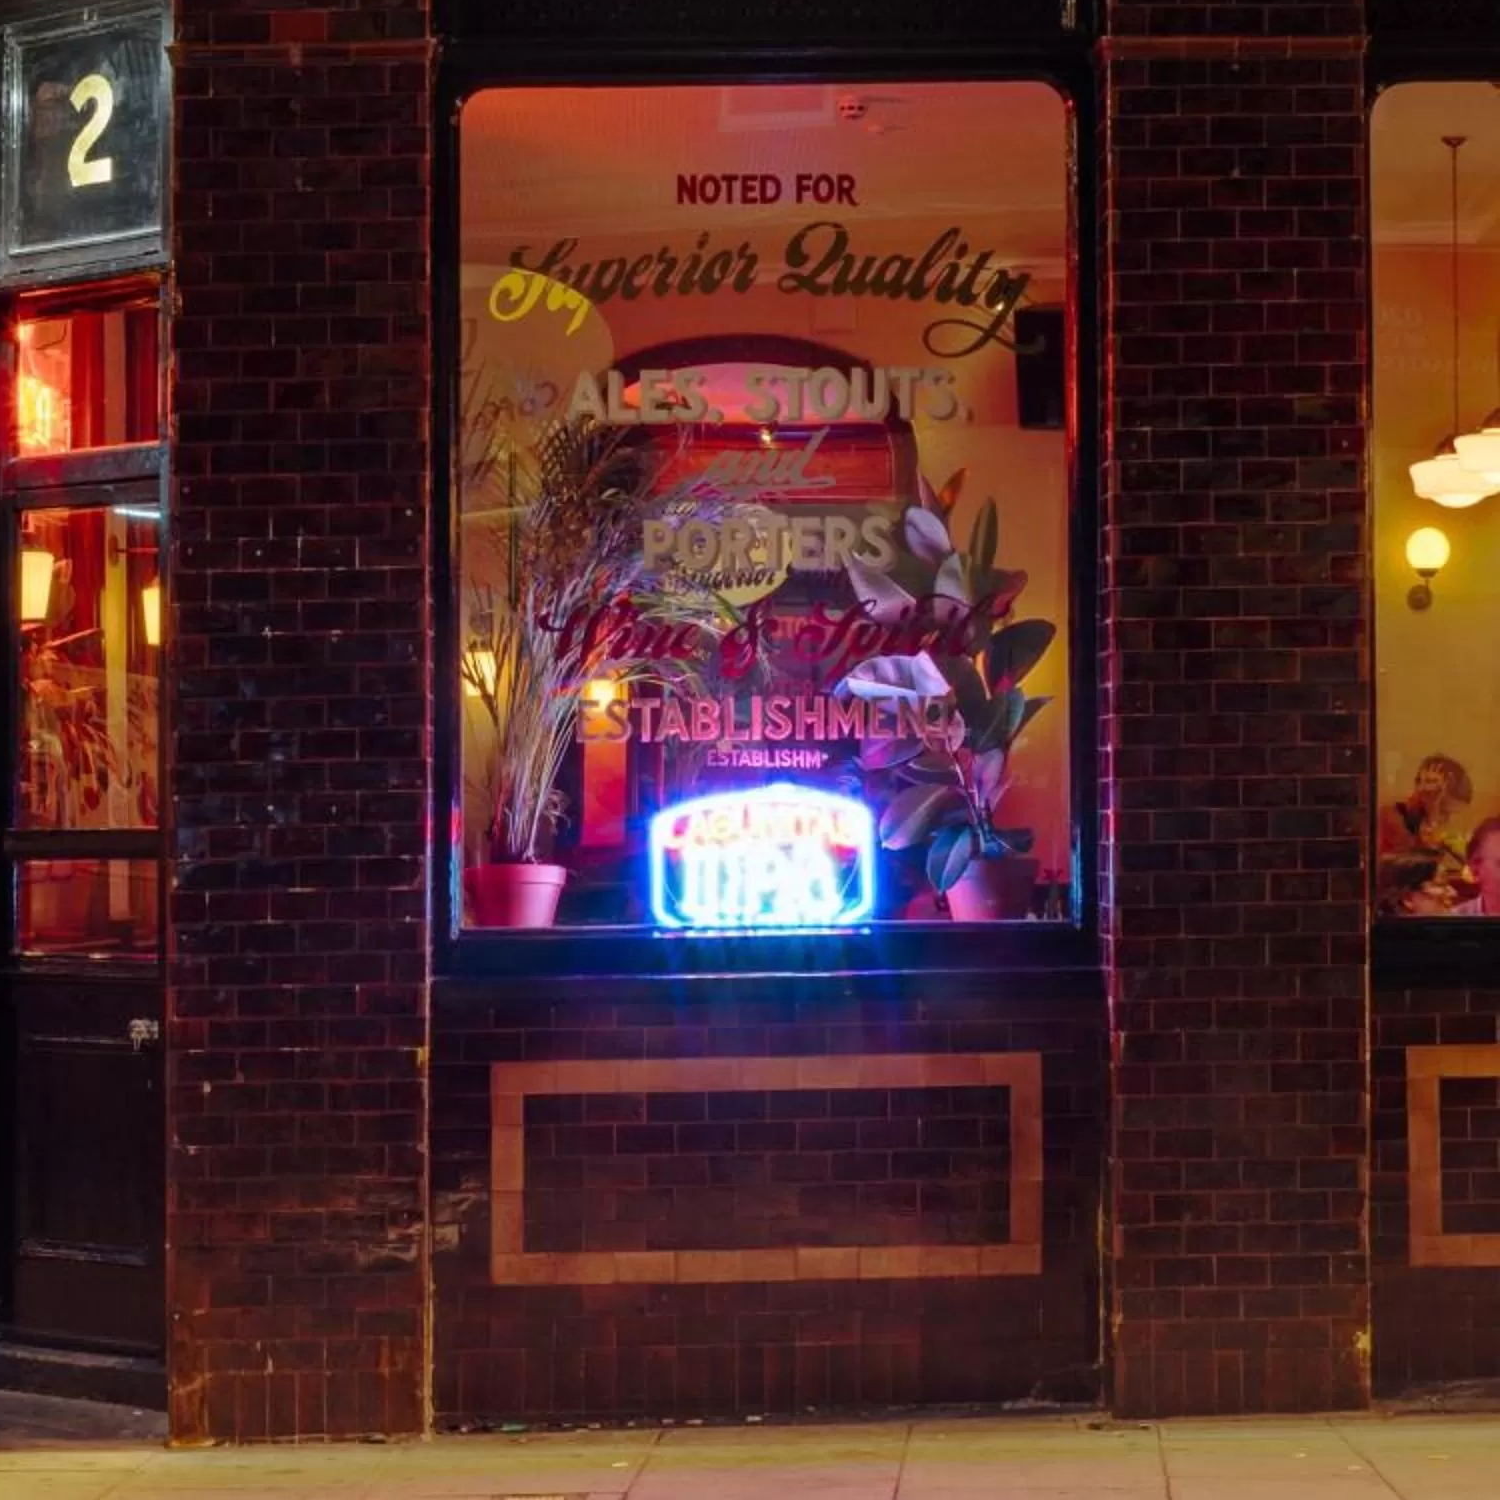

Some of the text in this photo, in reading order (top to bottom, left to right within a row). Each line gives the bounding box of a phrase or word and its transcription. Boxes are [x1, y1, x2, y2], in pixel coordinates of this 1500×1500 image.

[67, 73, 114, 187] 2
[676, 173, 859, 207] NOTED FOR
[489, 221, 1047, 359] Superior Quality
[695, 426, 837, 490] and
[642, 512, 898, 573] PORTERS
[577, 694, 950, 743] ESTABLISHMENT
